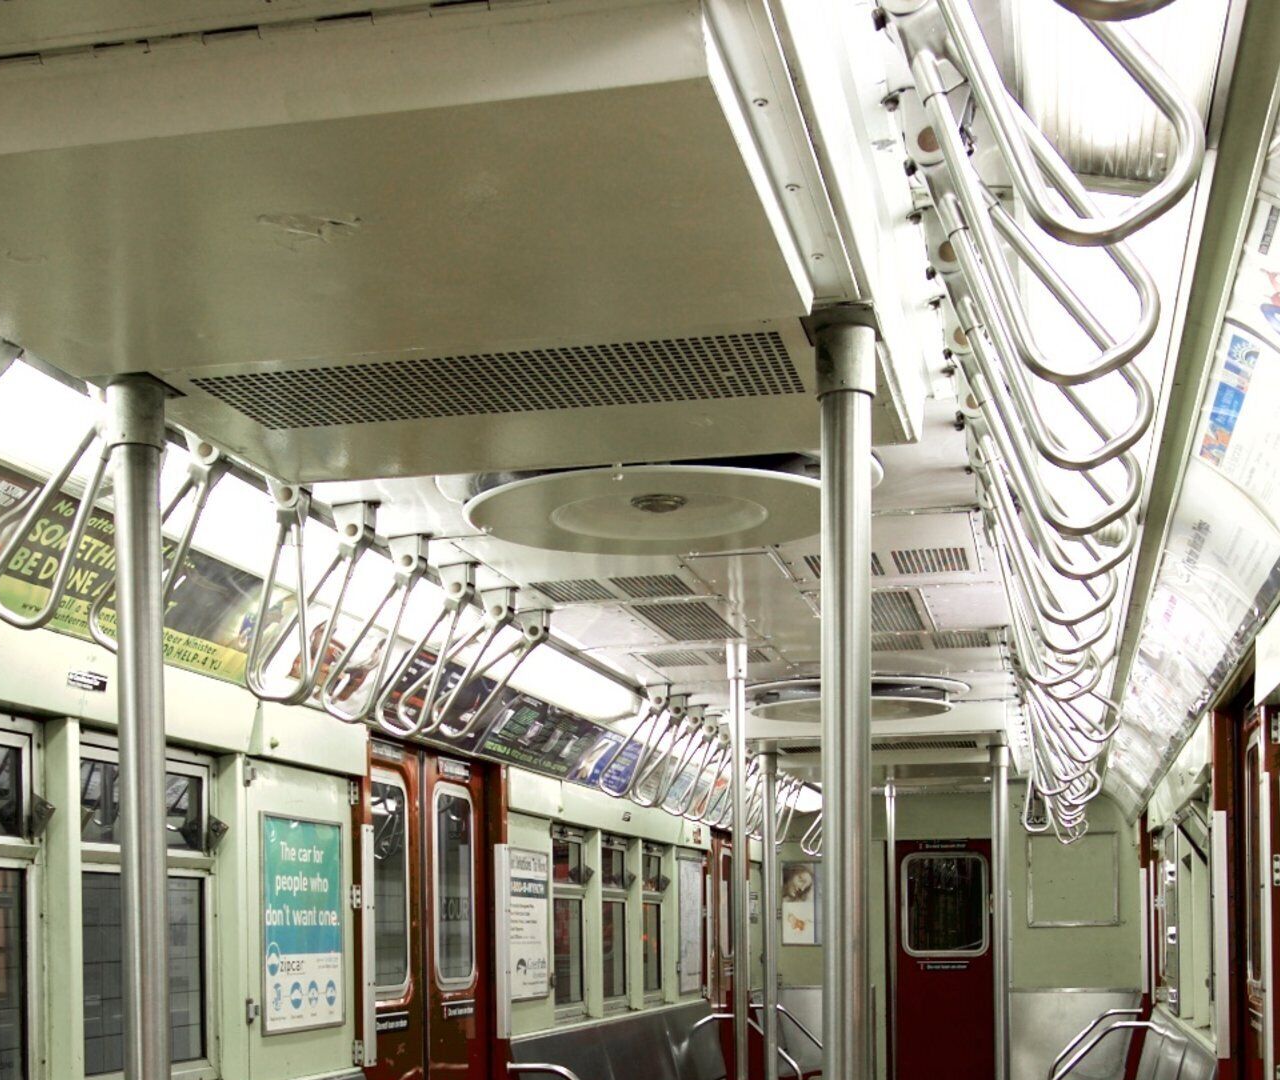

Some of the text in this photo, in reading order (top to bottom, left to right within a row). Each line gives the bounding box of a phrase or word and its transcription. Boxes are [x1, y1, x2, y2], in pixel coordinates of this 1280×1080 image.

[51, 499, 116, 534] No atter
[7, 545, 40, 578] BE
[279, 841, 297, 862] The
[297, 848, 312, 863] car
[275, 871, 329, 897] people who
[265, 903, 340, 927] don't want one.
[279, 956, 305, 975] zipcar
